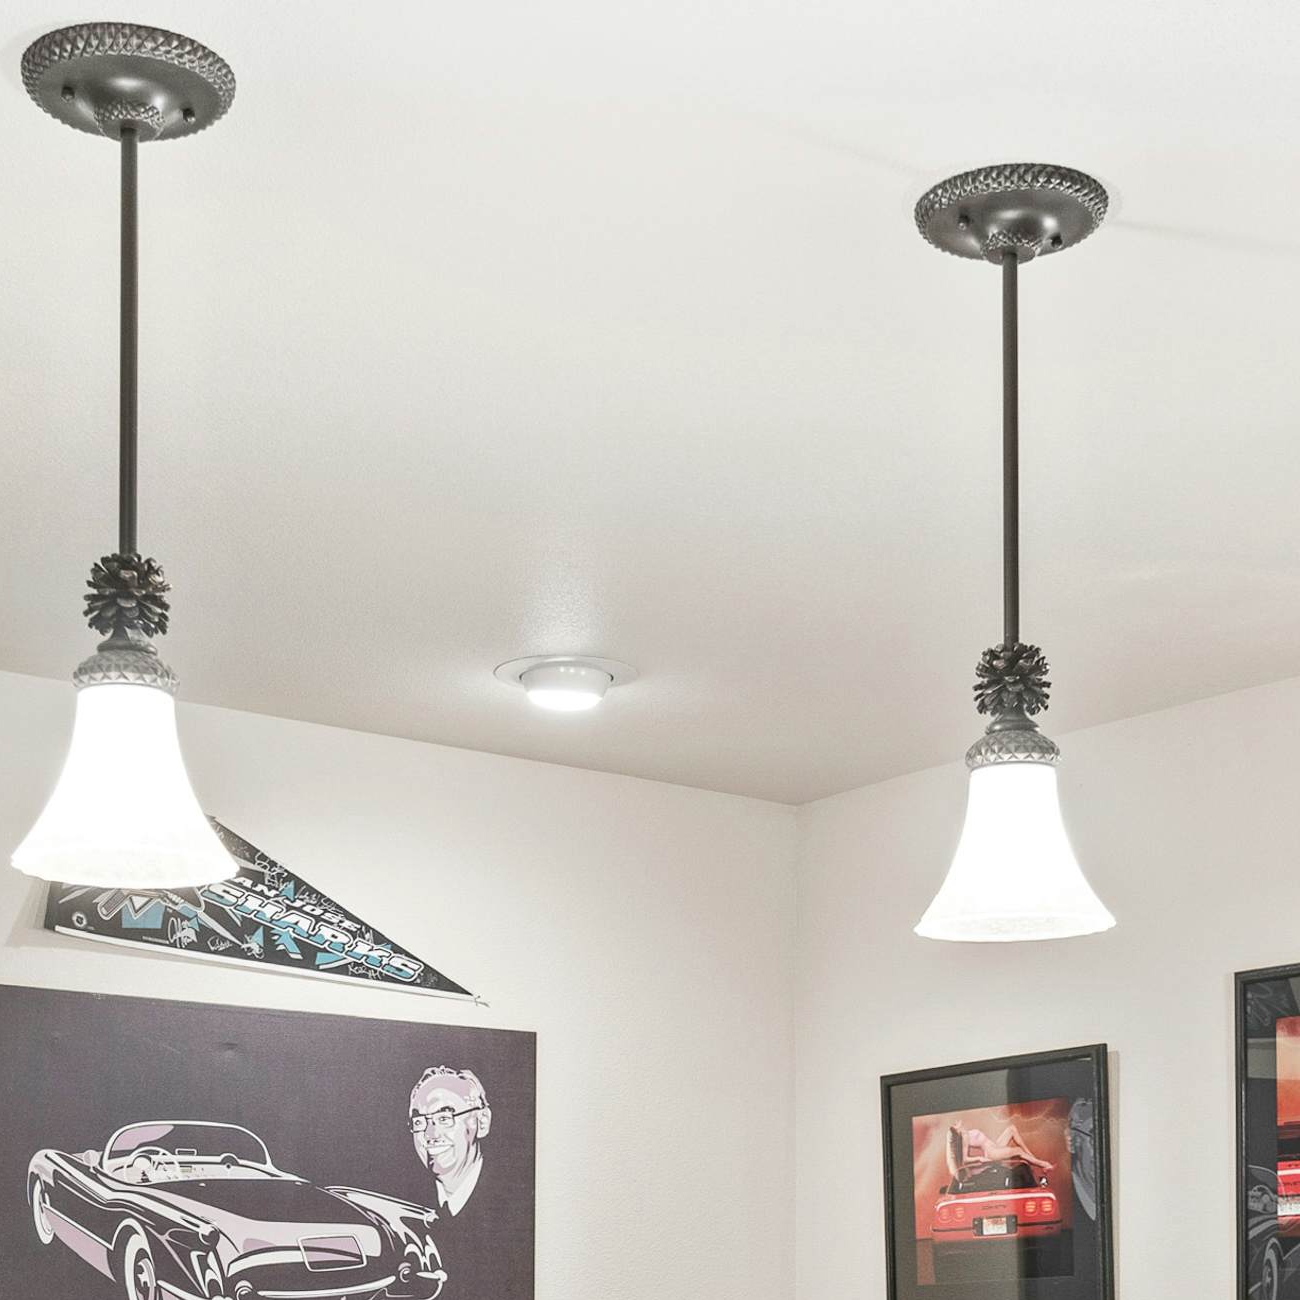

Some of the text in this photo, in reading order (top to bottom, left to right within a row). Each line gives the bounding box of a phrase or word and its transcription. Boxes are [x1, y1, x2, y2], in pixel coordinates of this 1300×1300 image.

[200, 881, 424, 982] SHARKS
[233, 877, 361, 932] AN JOSE
